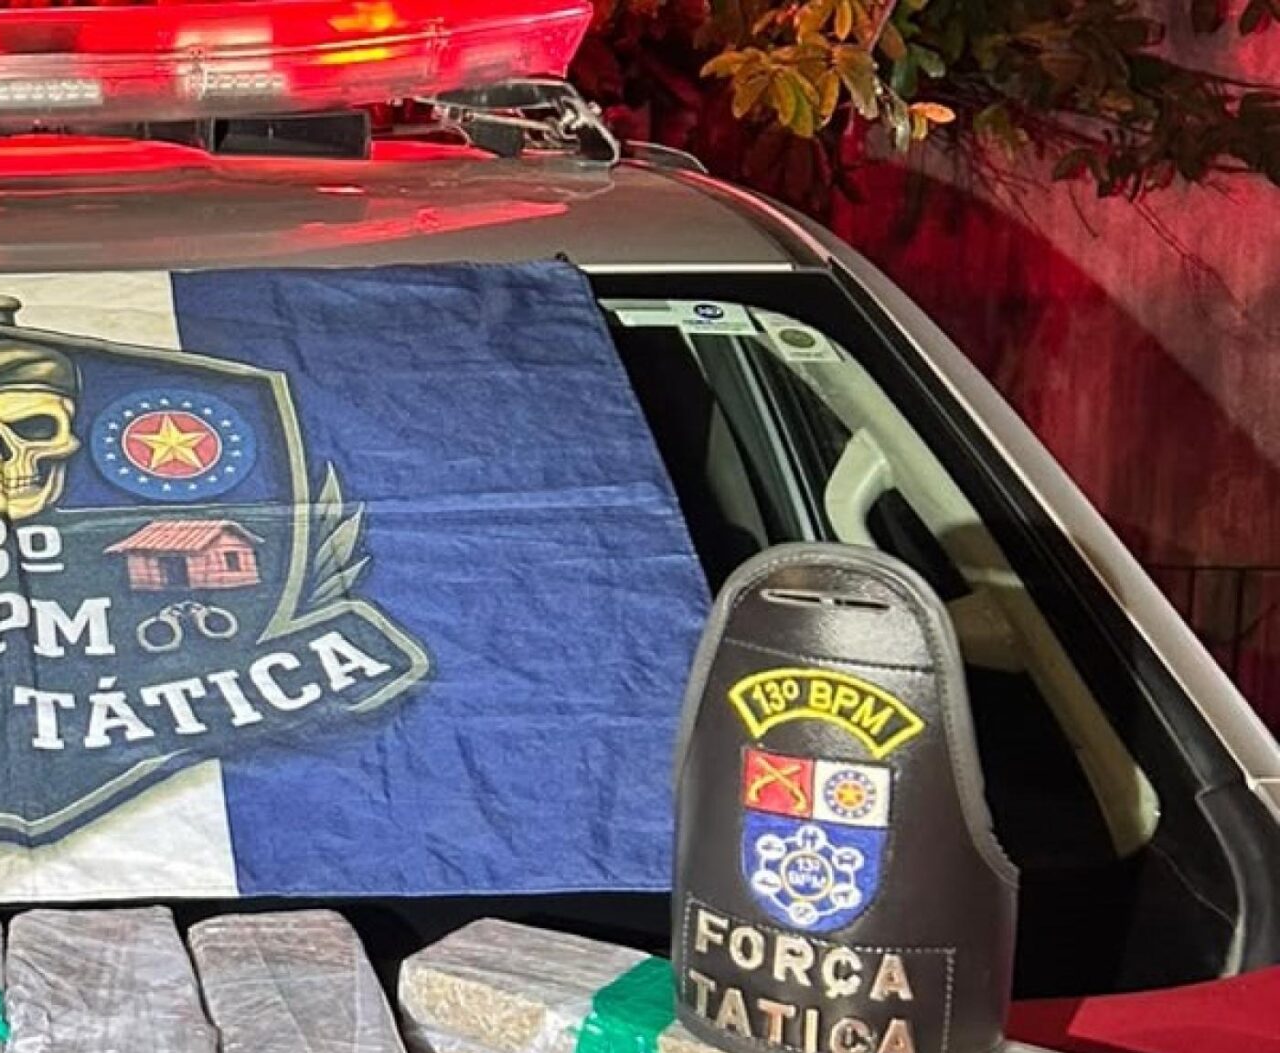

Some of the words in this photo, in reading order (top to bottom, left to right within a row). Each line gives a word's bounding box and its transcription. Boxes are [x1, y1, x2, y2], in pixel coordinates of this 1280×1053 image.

[12, 630, 392, 752] TÁTICA
[808, 679, 896, 736] BPM
[694, 908, 915, 1001] FORÇA
